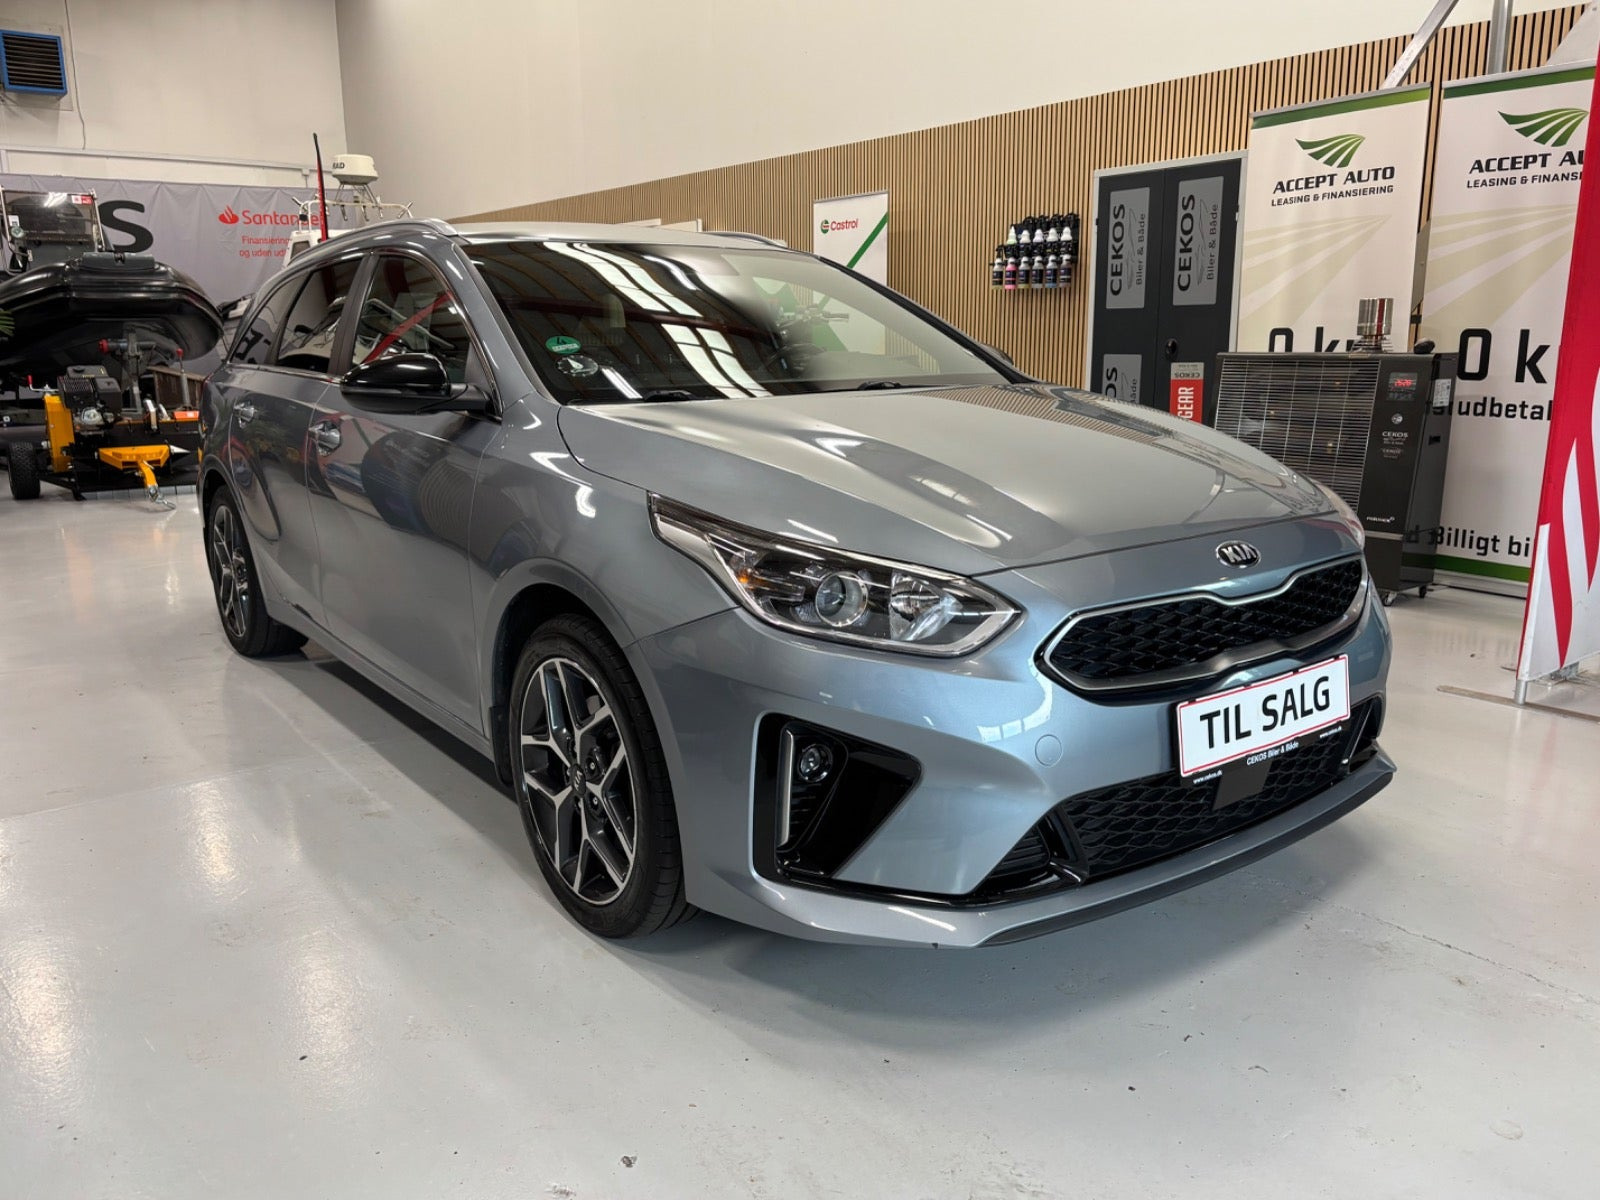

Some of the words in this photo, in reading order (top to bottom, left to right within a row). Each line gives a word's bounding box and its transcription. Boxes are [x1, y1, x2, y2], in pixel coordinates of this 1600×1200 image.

[1468, 153, 1552, 174] ACCEPT
[1273, 173, 1338, 194] ACCEPT
[1343, 166, 1395, 185] AUTO
[1466, 176, 1517, 189] LEASING
[1520, 176, 1528, 185] &
[1271, 194, 1310, 207] LEASING
[1313, 194, 1320, 202] &
[1321, 185, 1394, 201] FINANSIERING
[242, 210, 320, 225] Santane
[830, 218, 859, 231] Castrol
[1138, 213, 1146, 244] Både
[1209, 203, 1219, 235] Både
[240, 249, 250, 258] og
[252, 248, 272, 257] uden
[1110, 203, 1126, 296] CEKOS
[1137, 246, 1144, 258] &
[1177, 194, 1195, 291] CEKOS
[1208, 240, 1217, 253] &
[1135, 259, 1143, 285] Biler
[1206, 254, 1214, 280] Biler
[1457, 396, 1553, 421] udbetal
[1220, 543, 1257, 563] KIA
[1200, 704, 1252, 749] TIL
[1262, 676, 1330, 732] SALG
[1246, 752, 1267, 766] CEKOS
